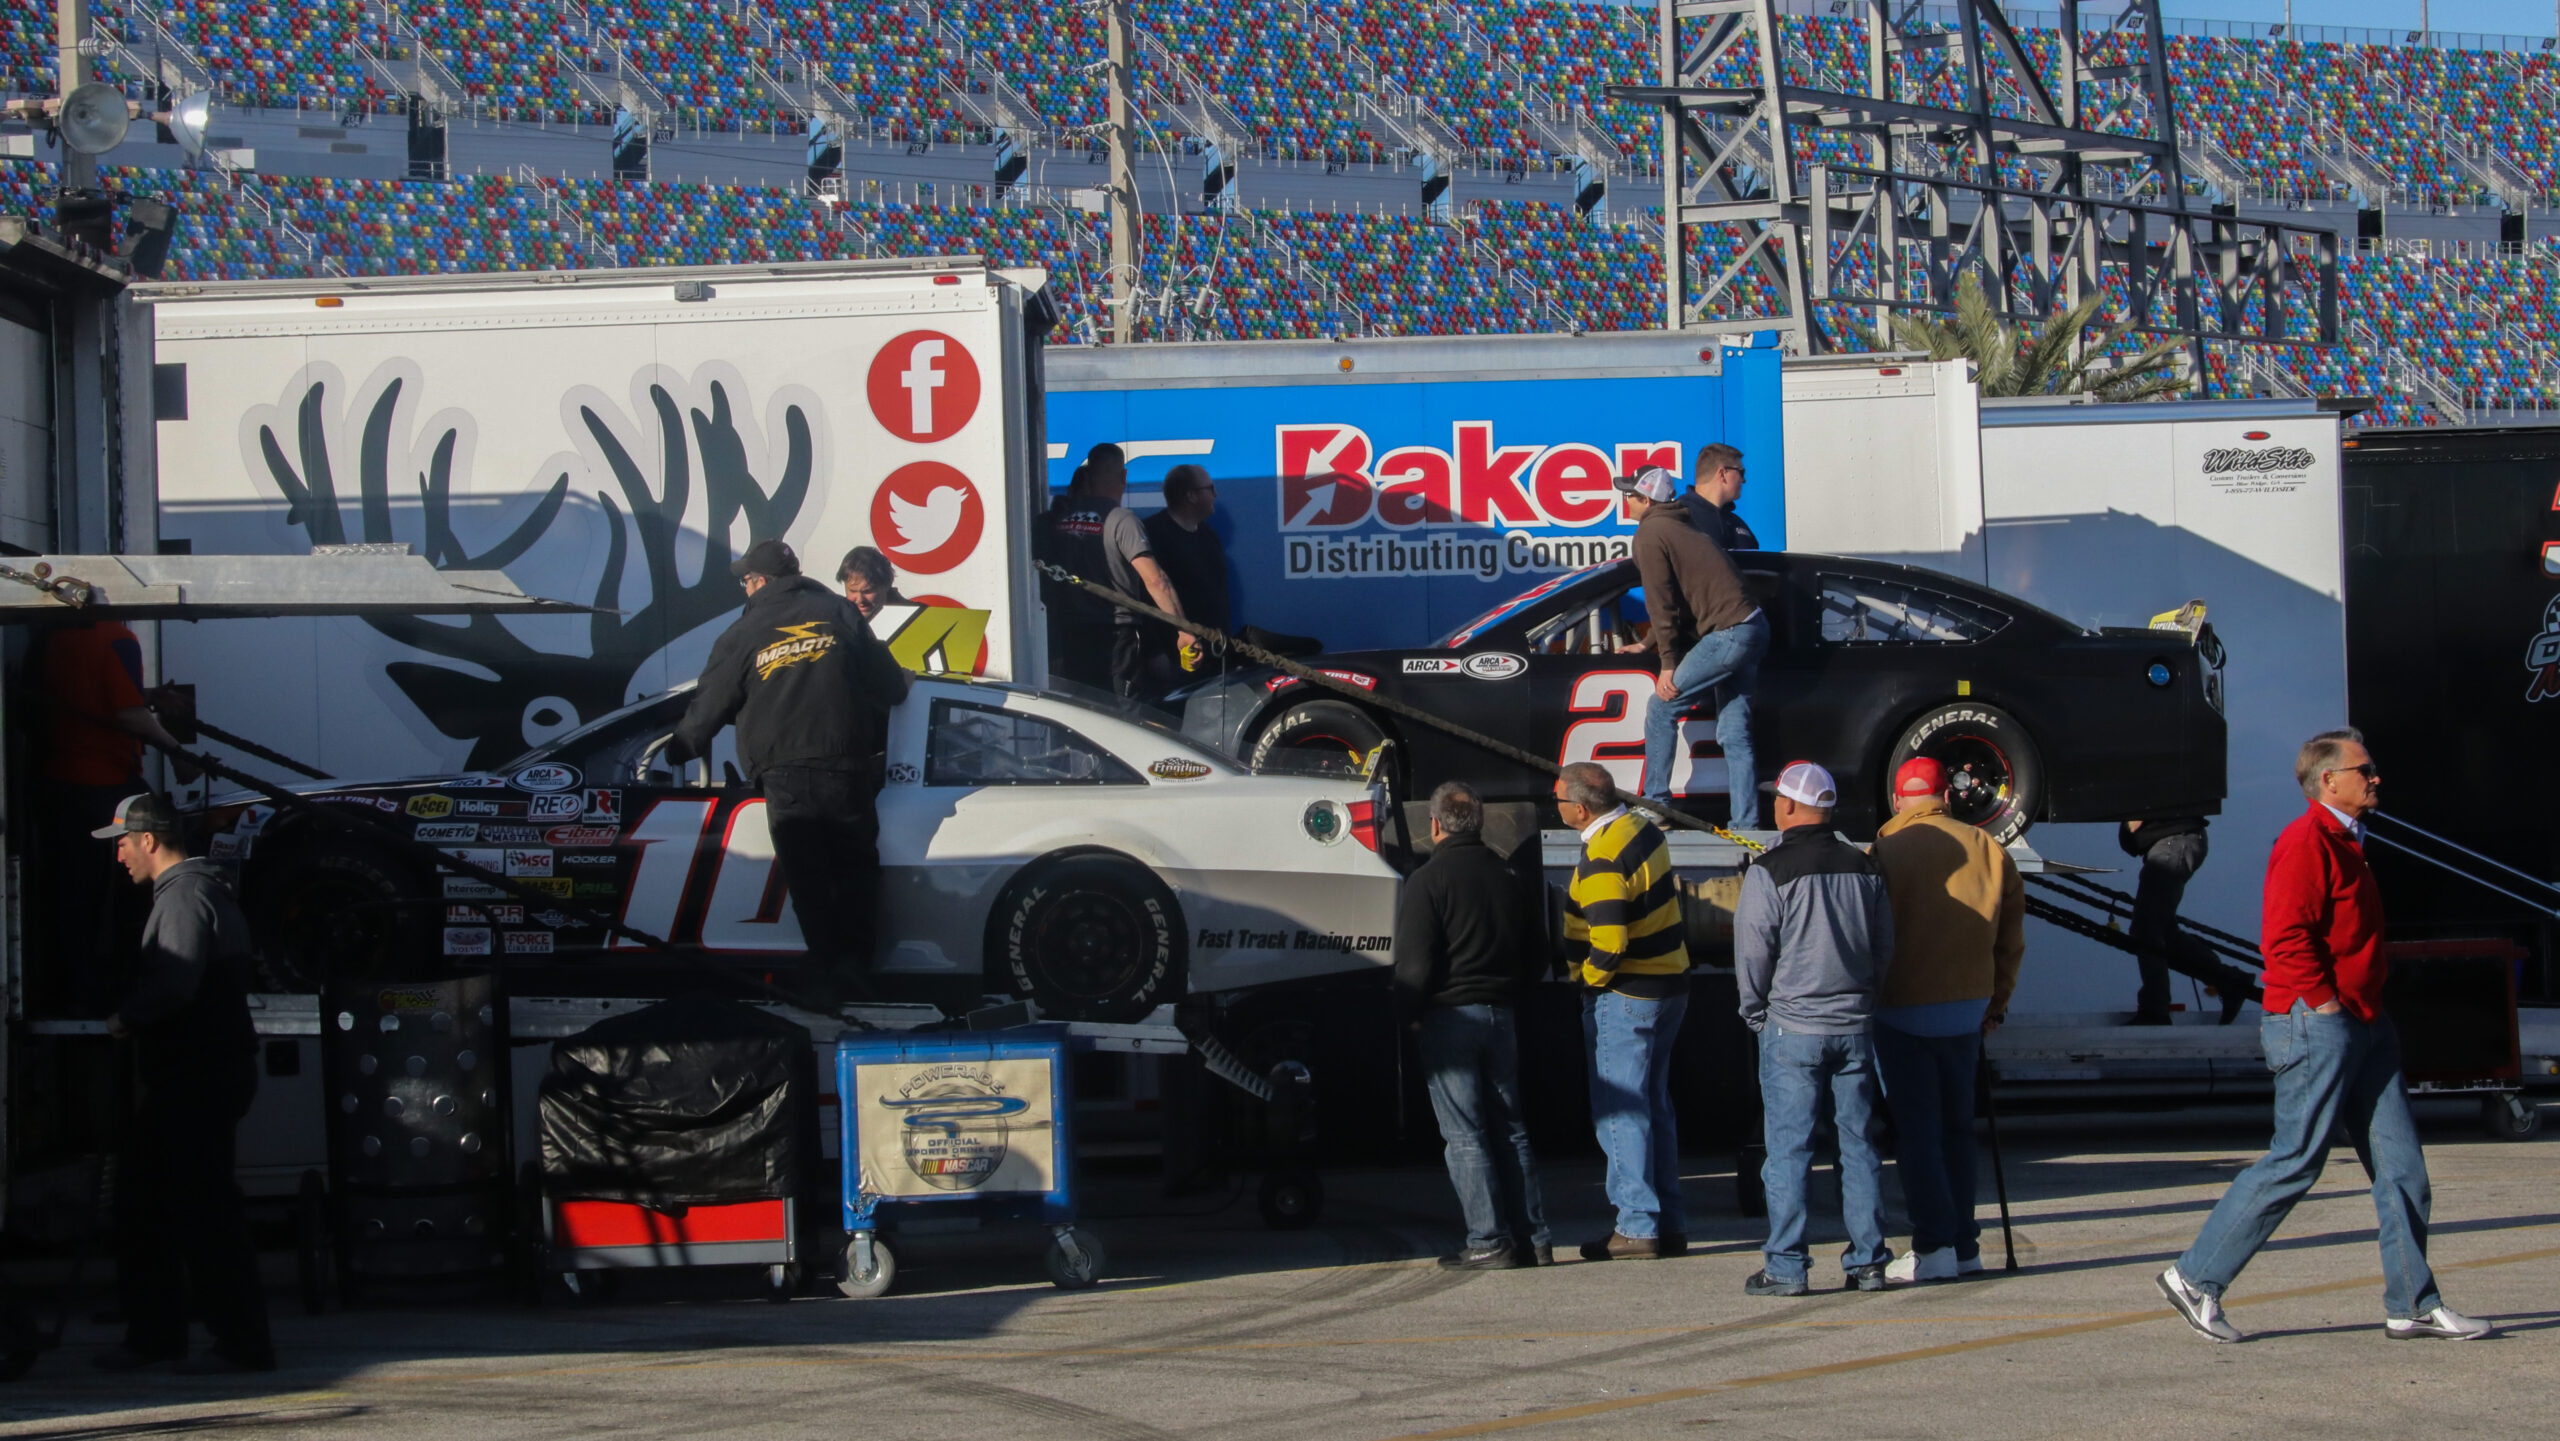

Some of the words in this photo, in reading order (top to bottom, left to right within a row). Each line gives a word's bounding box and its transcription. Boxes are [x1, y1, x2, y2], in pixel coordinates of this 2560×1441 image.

[343, 114, 361, 127] 334
[655, 129, 671, 143] 333
[909, 142, 925, 155] 332
[1091, 151, 1105, 164] 331
[1328, 162, 1343, 175] 330
[1508, 170, 1522, 183] 329
[2141, 195, 2153, 207] 325
[1279, 422, 1680, 530] Baker
[1289, 536, 1498, 577] Distributing
[1507, 534, 1632, 569] Compa
[757, 649, 829, 681] Racing
[1405, 660, 1441, 672] ARCA
[1478, 656, 1500, 665] ARCA
[1324, 671, 1351, 680] TIRE
[1909, 709, 1999, 751] GENERAL
[1250, 712, 1312, 776] ENERAL
[526, 768, 552, 779] ARCA
[409, 798, 449, 816] ACCEL
[458, 800, 500, 816] Holley
[482, 826, 538, 838] QUARTER
[492, 834, 542, 842] MASTER
[546, 825, 618, 842] Eibach
[519, 855, 551, 867] MSG
[562, 855, 617, 864] HOOKER
[447, 884, 496, 896] Intercomp
[506, 934, 550, 945] -FORCE
[1008, 886, 1047, 992] GENERAL
[1196, 928, 1234, 948] Fast
[1238, 930, 1289, 949] Track
[1293, 930, 1393, 954] Racing.com
[1132, 898, 1169, 1003] GENERAL
[899, 1064, 1005, 1099] POWERADE
[928, 1137, 981, 1147] OFFICIAL
[906, 1147, 947, 1156] SPORTS
[952, 1146, 985, 1155] DRINK
[942, 1158, 989, 1173] NASCAR
